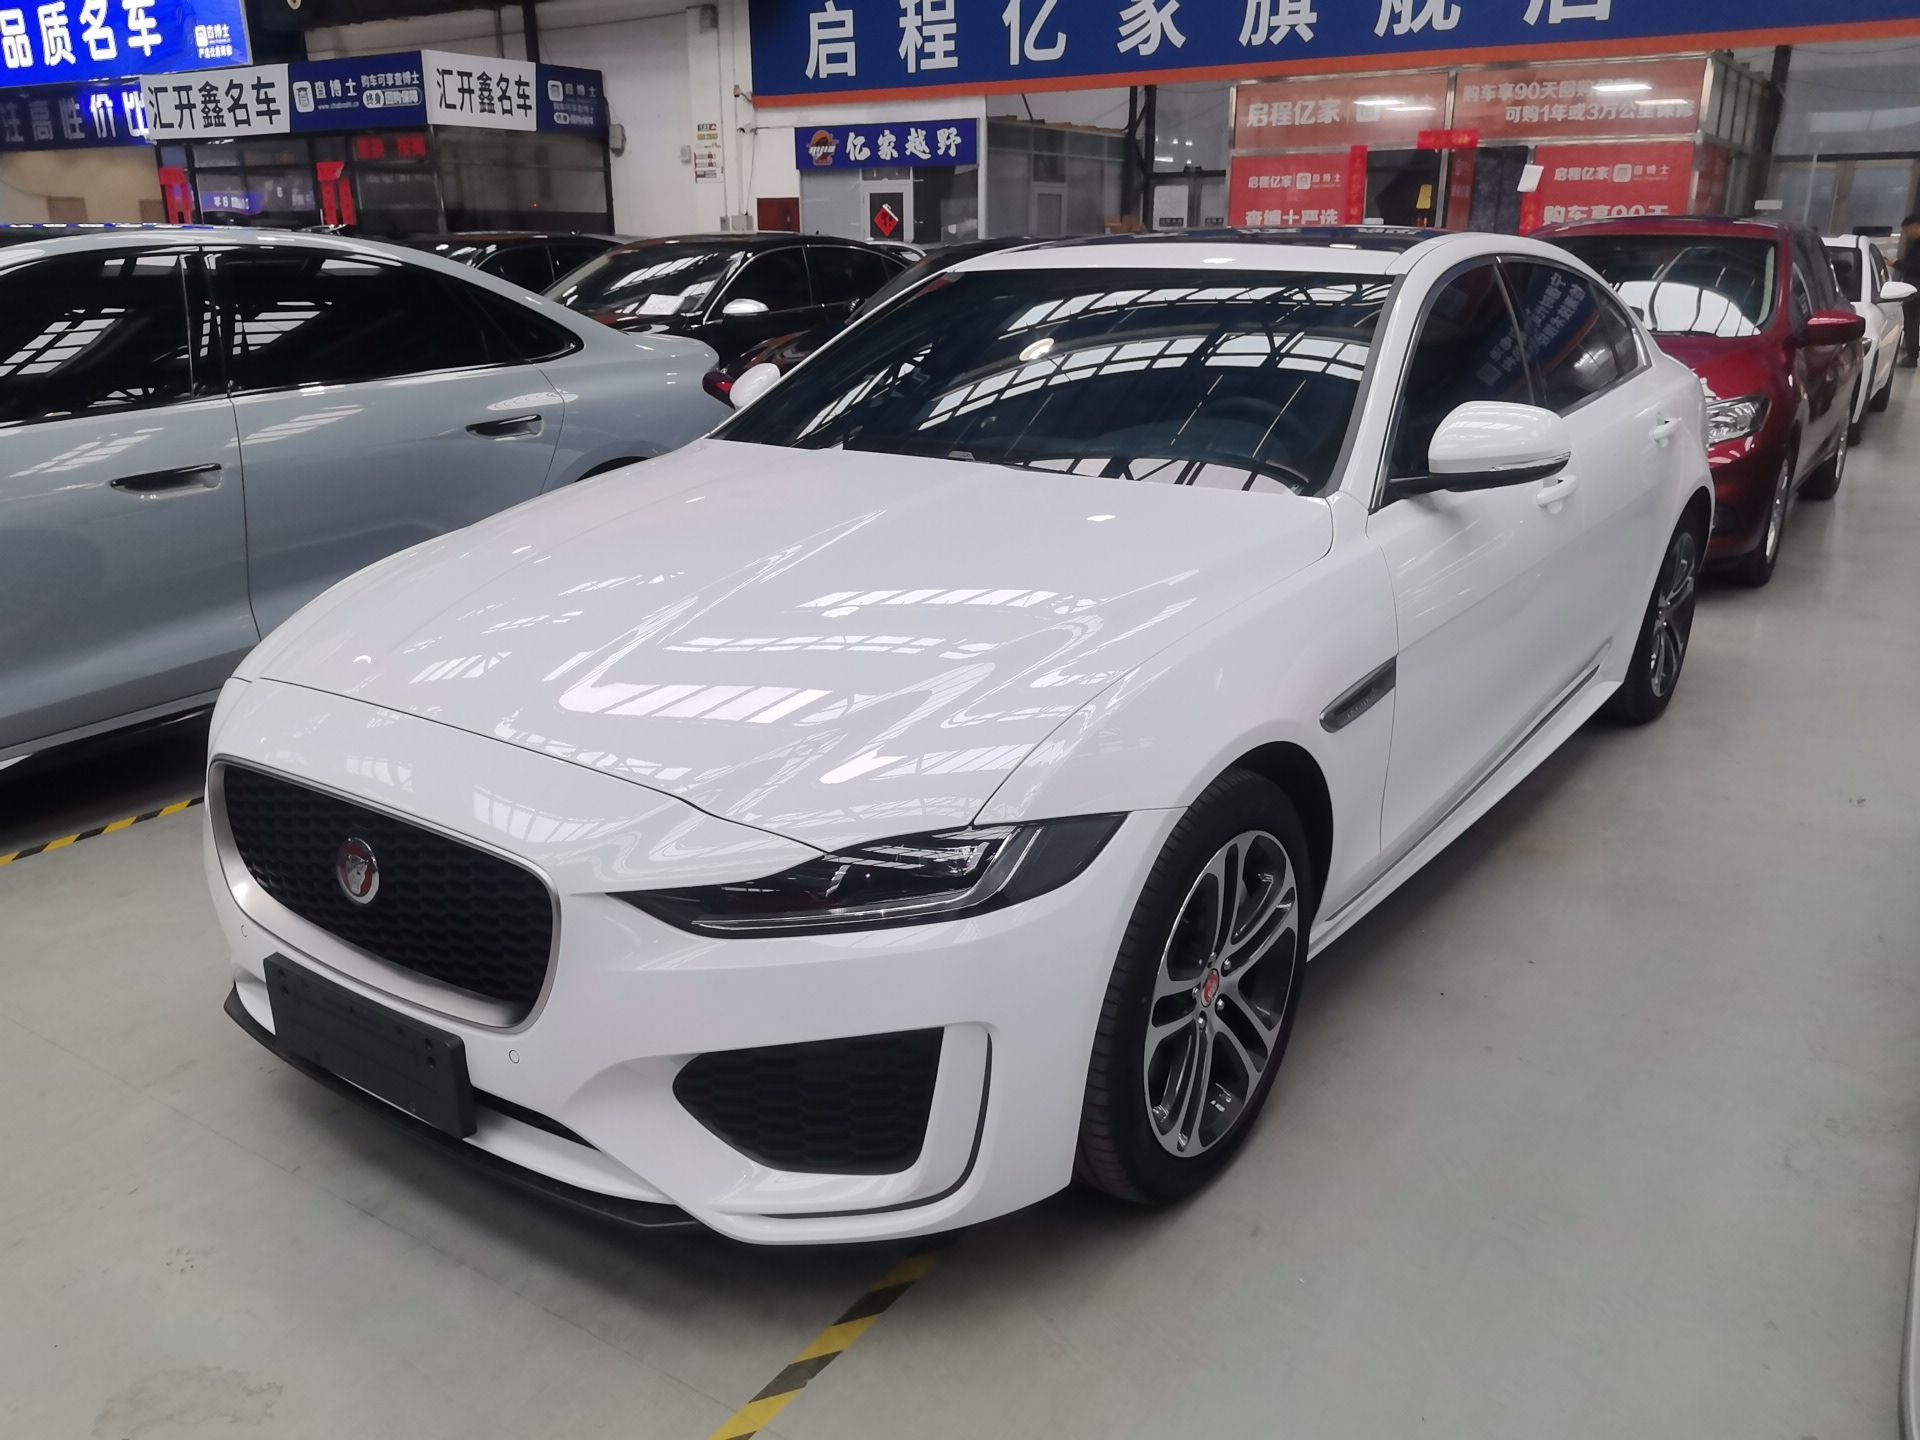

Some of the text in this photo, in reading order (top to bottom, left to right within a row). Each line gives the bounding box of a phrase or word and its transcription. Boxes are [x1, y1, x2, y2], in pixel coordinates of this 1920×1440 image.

[0, 0, 163, 69] 品质名车
[804, 0, 1612, 79] 启程亿家旗
[147, 76, 282, 130] 汇开鑫名车
[314, 78, 358, 99] 查博士
[436, 67, 533, 118] 汇开鑫名车
[1247, 99, 1341, 127] 启程亿家
[845, 127, 962, 160] 亿家越野
[1247, 175, 1293, 189] 启程亿家
[1554, 166, 1610, 182] 启程亿家
